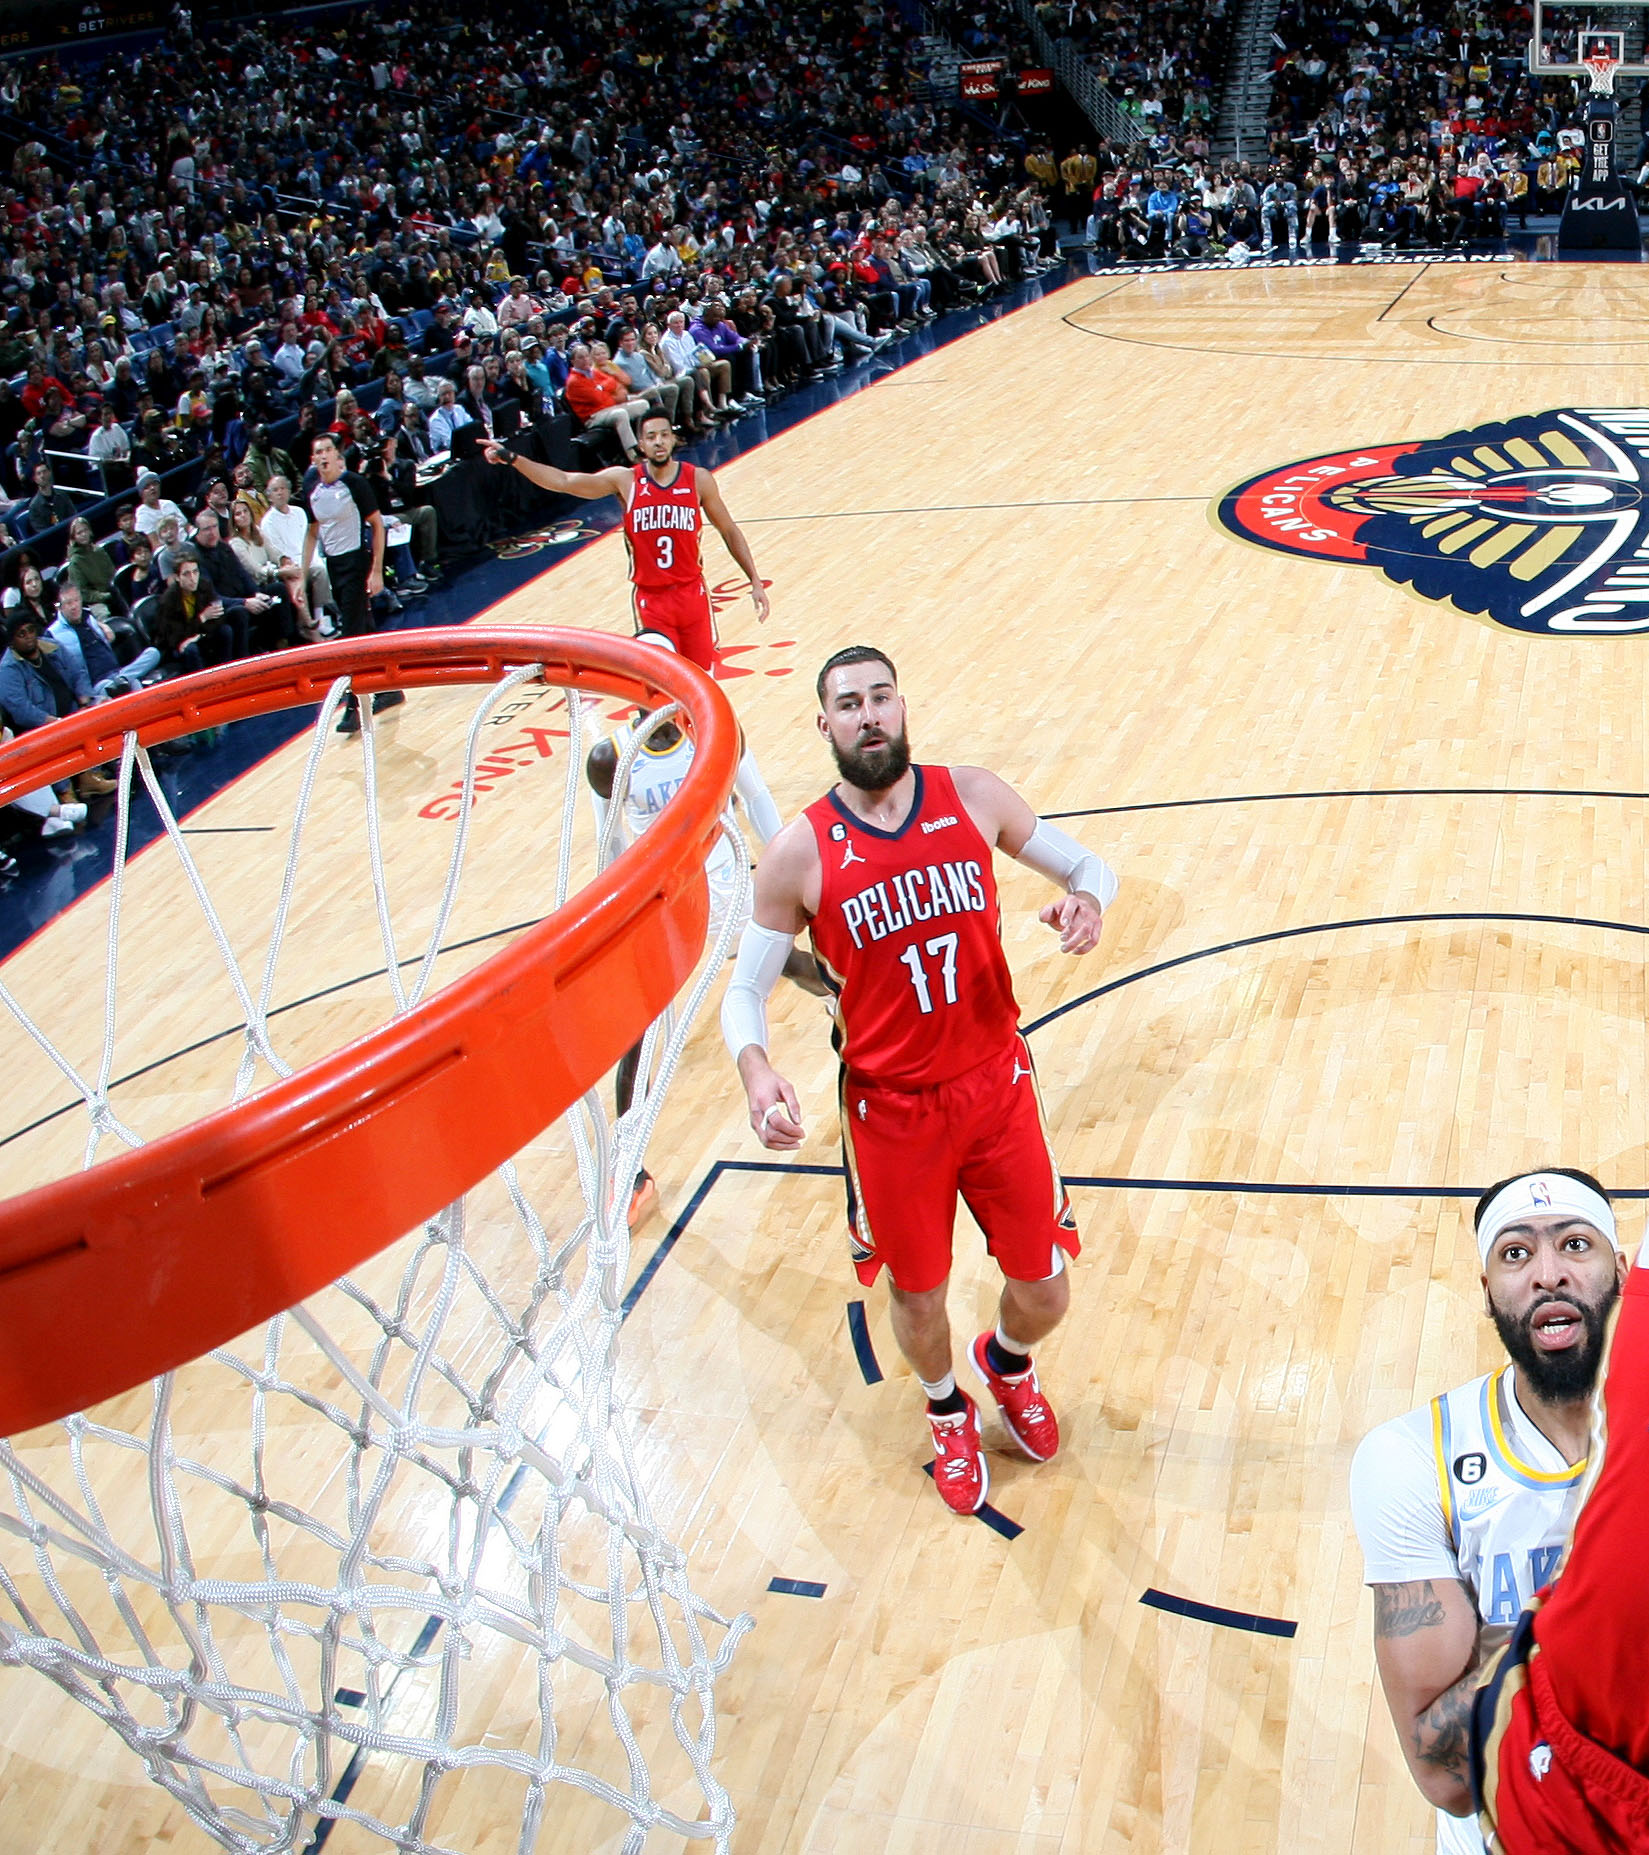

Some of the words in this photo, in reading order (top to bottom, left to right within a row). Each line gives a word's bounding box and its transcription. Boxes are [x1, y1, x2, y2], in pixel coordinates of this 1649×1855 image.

[1593, 143, 1609, 156] GET
[1593, 156, 1609, 169] THE
[1592, 169, 1609, 182] APP
[1095, 264, 1180, 276] NEW
[1184, 257, 1339, 270] ORLEANS
[1351, 254, 1515, 264] PELICANS
[1258, 455, 1379, 544] PELICANS
[633, 504, 696, 533] PELICANS
[657, 535, 674, 570] 3
[832, 824, 845, 840] 6
[921, 816, 958, 834] ibotta
[841, 860, 986, 949] PELICANS
[899, 932, 959, 1014] 17
[1461, 1453, 1481, 1483] 6
